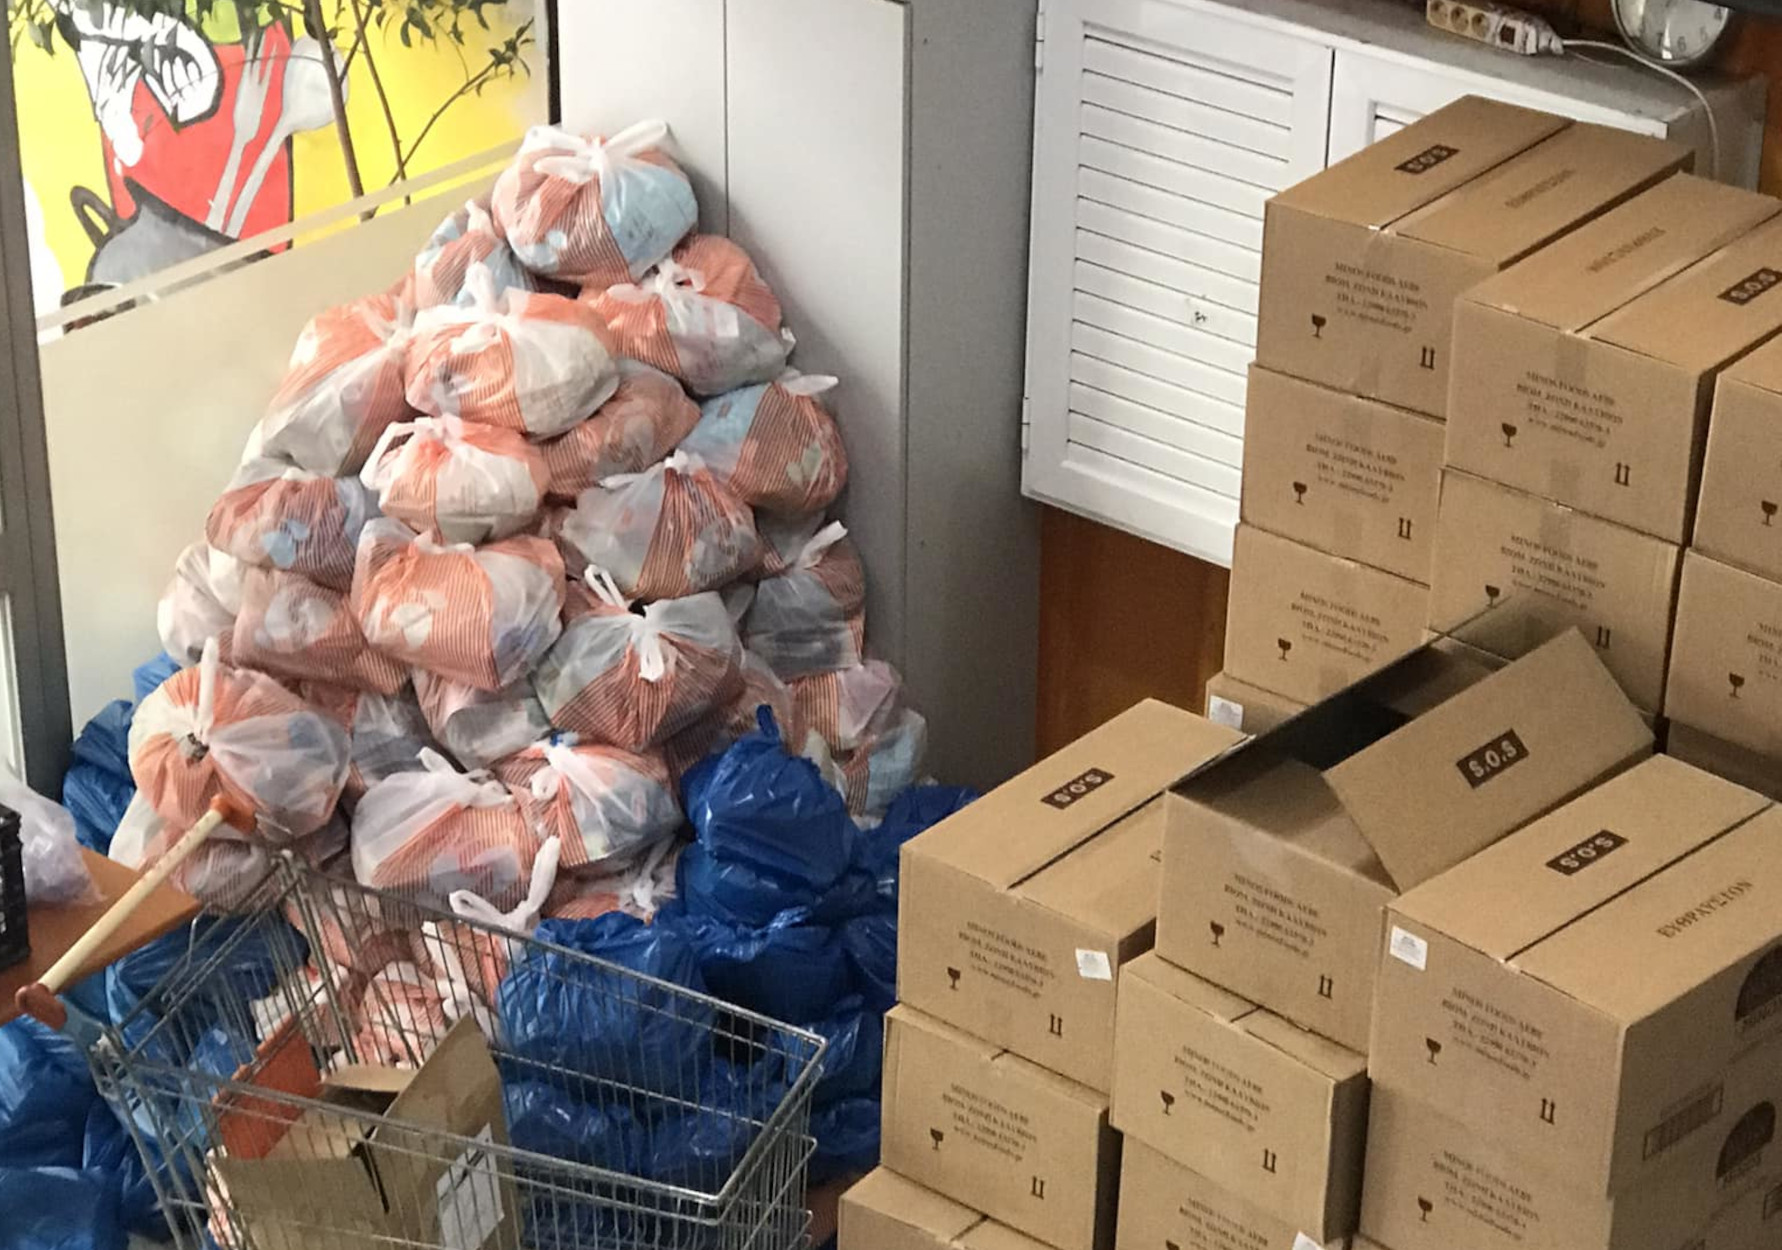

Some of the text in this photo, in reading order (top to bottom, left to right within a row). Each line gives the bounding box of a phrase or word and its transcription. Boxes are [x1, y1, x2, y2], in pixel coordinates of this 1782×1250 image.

[1469, 740, 1517, 777] S.O.S
[1054, 774, 1102, 802] S.O.S
[1560, 837, 1614, 867] S.O.S
